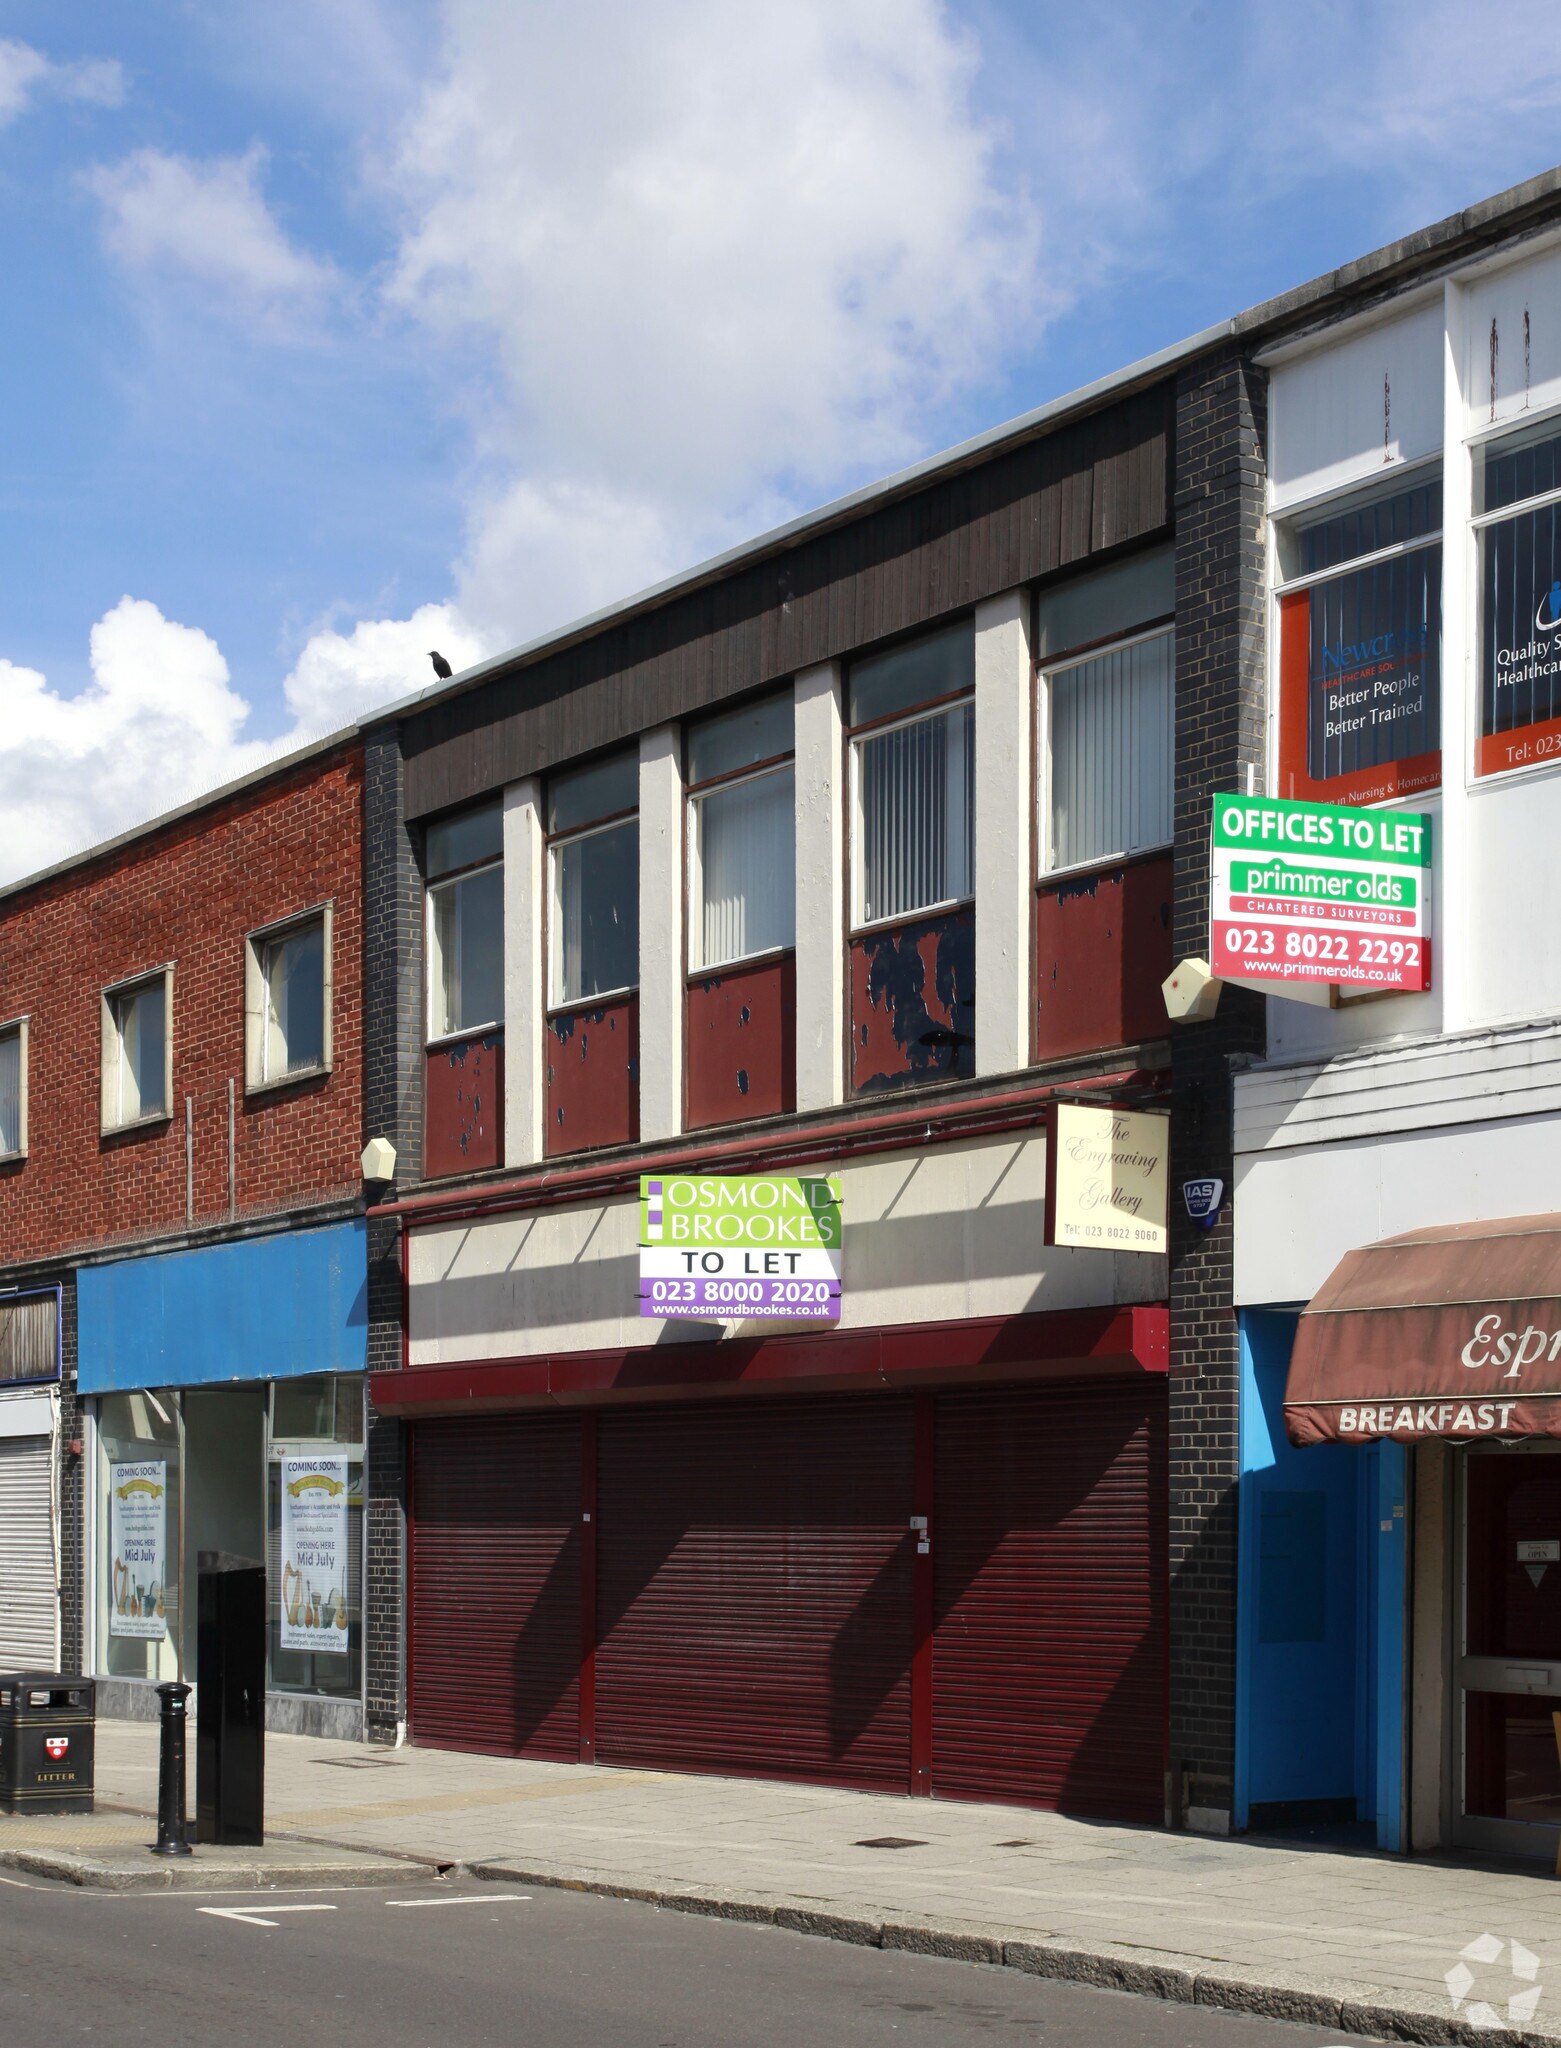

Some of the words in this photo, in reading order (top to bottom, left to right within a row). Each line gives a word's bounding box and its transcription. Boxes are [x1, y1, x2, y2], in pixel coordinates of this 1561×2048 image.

[1497, 640, 1550, 666] Quality
[1322, 666, 1376, 690] HEALTHCARE
[1329, 688, 1370, 711] Better
[1374, 672, 1419, 697] People
[1326, 714, 1366, 738] Better
[1370, 696, 1423, 725] Trained
[1506, 742, 1532, 763] Tel:
[1536, 733, 1561, 756] 023
[1349, 785, 1385, 804] Nursing
[1387, 782, 1394, 793] &
[1222, 807, 1334, 844] OFFICES
[1338, 819, 1374, 848] TO
[1381, 822, 1424, 854] LET
[1247, 864, 1352, 897] primmer
[1356, 872, 1402, 902] olds
[1247, 900, 1325, 916] CHARTERED
[1331, 907, 1402, 923] SURVEYORS
[1225, 928, 1275, 954] 023
[1285, 932, 1349, 960] 8022
[1358, 939, 1420, 967] 2292
[1243, 959, 1403, 982] www.primmerolds.co.uk
[1096, 1115, 1131, 1141] The
[1065, 1136, 1159, 1177] Engraving
[667, 1181, 835, 1208] OSMOND
[1079, 1177, 1144, 1216] Gallery
[1187, 1184, 1213, 1198] IAS
[671, 1214, 834, 1242] BROOKES
[1065, 1224, 1081, 1236] Tel:
[1085, 1225, 1103, 1237] 023
[1107, 1227, 1130, 1239] 8022
[1135, 1229, 1158, 1241] 9060
[681, 1251, 724, 1274] TO
[744, 1252, 802, 1274] LET
[652, 1281, 696, 1301] 023
[704, 1281, 764, 1302] 8000
[771, 1282, 830, 1303] 2020
[652, 1303, 830, 1316] www.osmondbrookes.co.uk
[1339, 1402, 1516, 1432] BREAKFAST
[117, 1468, 139, 1477] COMING
[287, 1461, 317, 1472] COMING
[124, 1539, 144, 1547] OPENING
[144, 1539, 156, 1547] HERE
[296, 1541, 320, 1550] OPENING
[320, 1541, 335, 1550] HERE
[125, 1549, 138, 1561] Mid
[140, 1548, 155, 1564] July
[297, 1552, 314, 1566] Mid
[316, 1552, 335, 1570] July
[37, 1771, 76, 1782] LITTER
